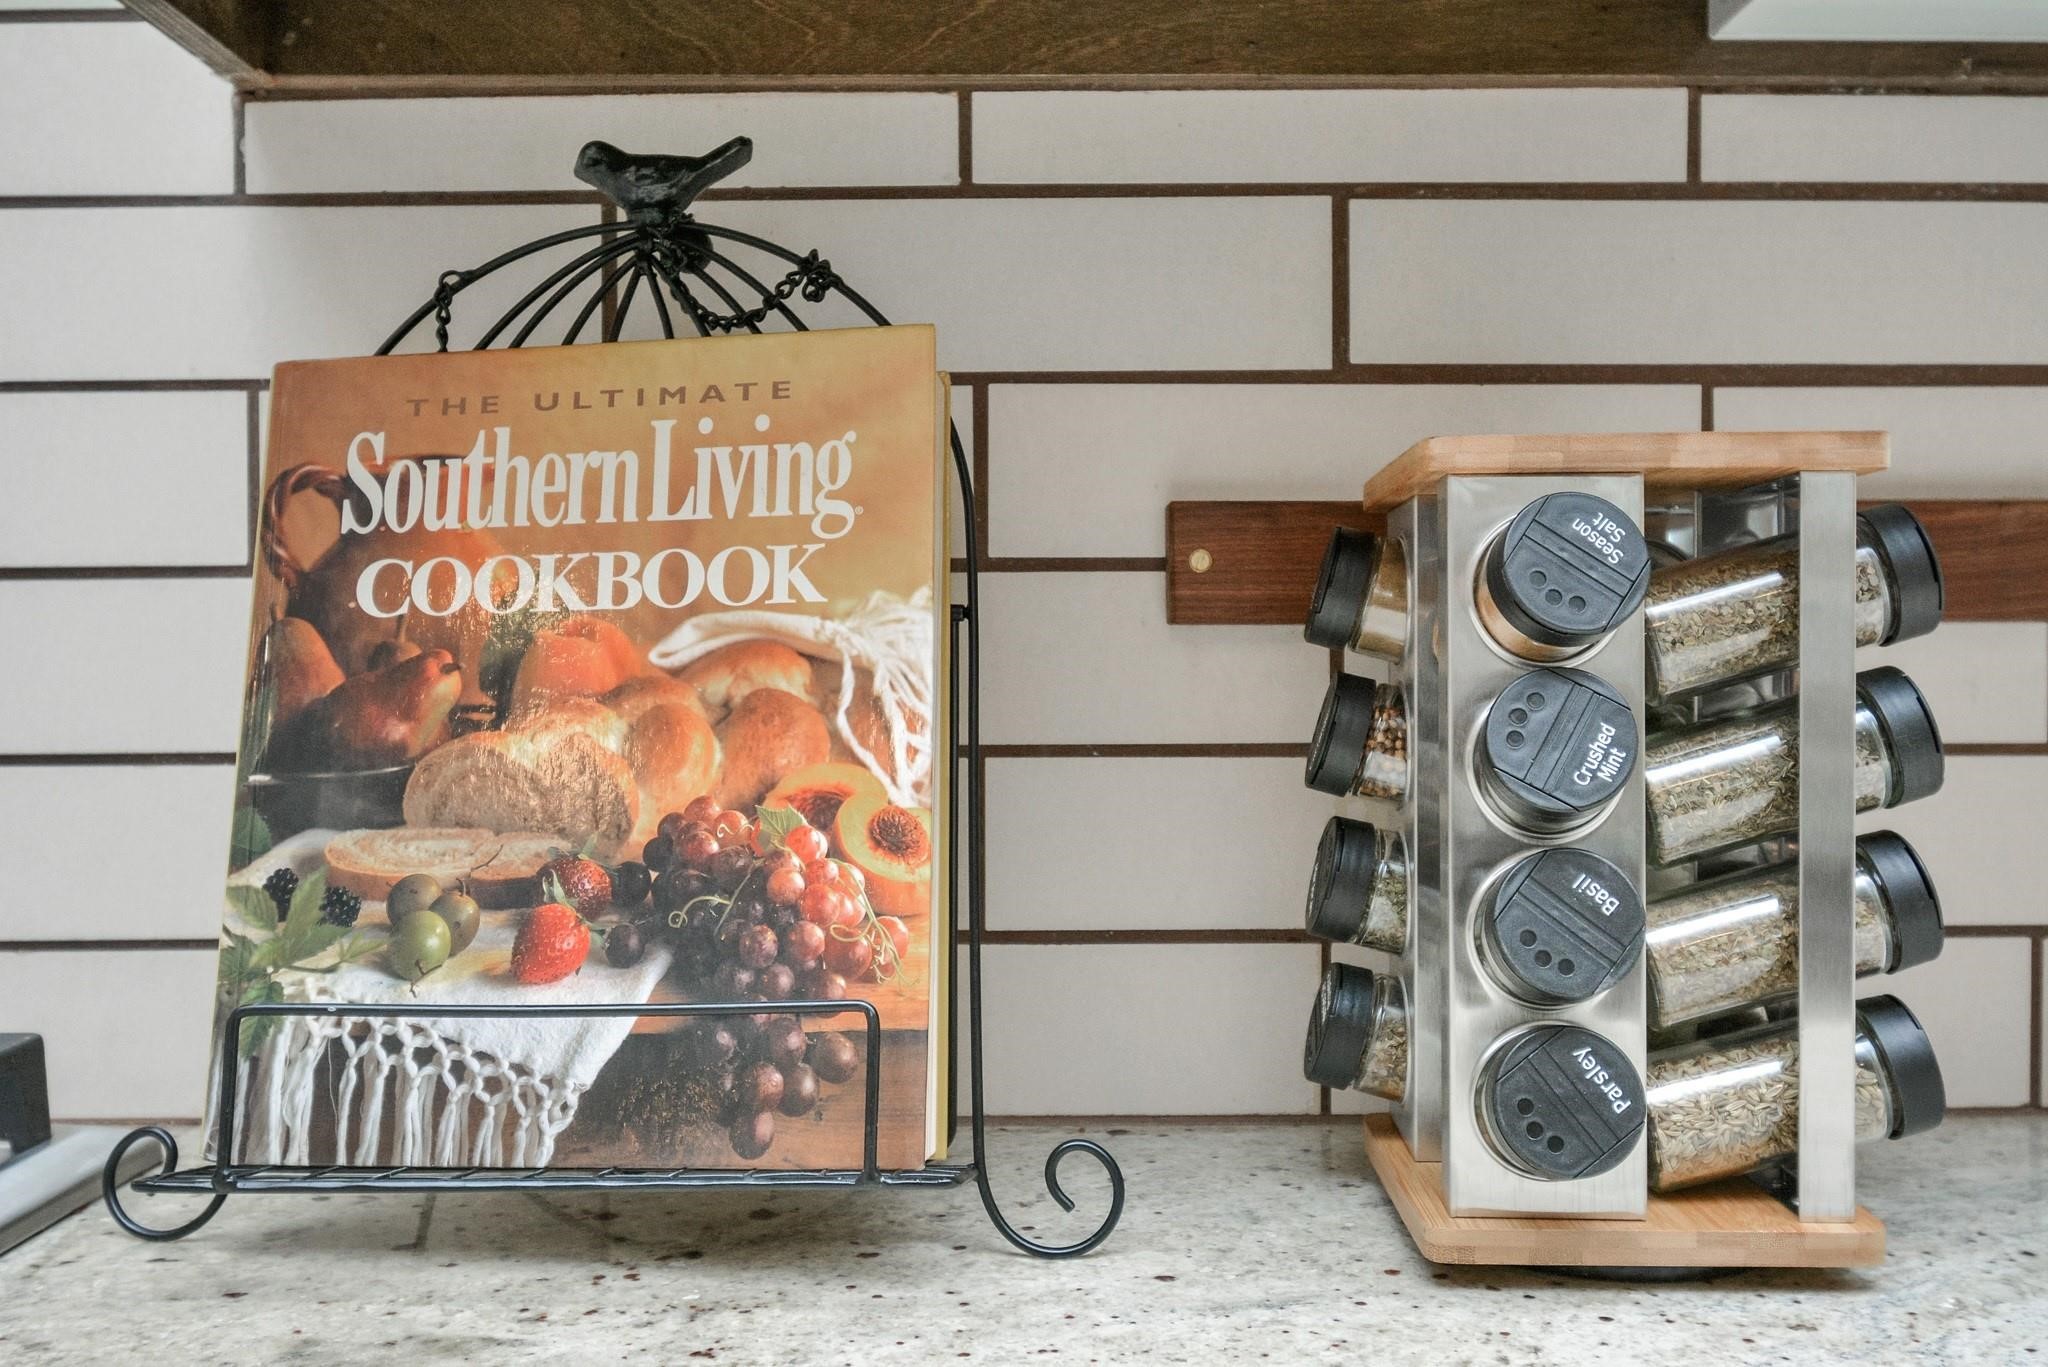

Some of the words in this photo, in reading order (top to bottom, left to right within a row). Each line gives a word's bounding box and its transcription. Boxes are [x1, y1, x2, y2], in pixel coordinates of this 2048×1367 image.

[407, 392, 500, 417] THE
[533, 380, 792, 411] ULTIMATE
[340, 426, 640, 535] Southern
[646, 414, 858, 540] Living
[1572, 518, 1625, 564] Season
[1592, 512, 1627, 543] Salt
[355, 542, 829, 619] COOKBOOK
[1573, 722, 1617, 786] Crushed
[1596, 747, 1627, 783] Mint
[1572, 873, 1620, 917] Basil
[1572, 1046, 1632, 1115] Parsley
